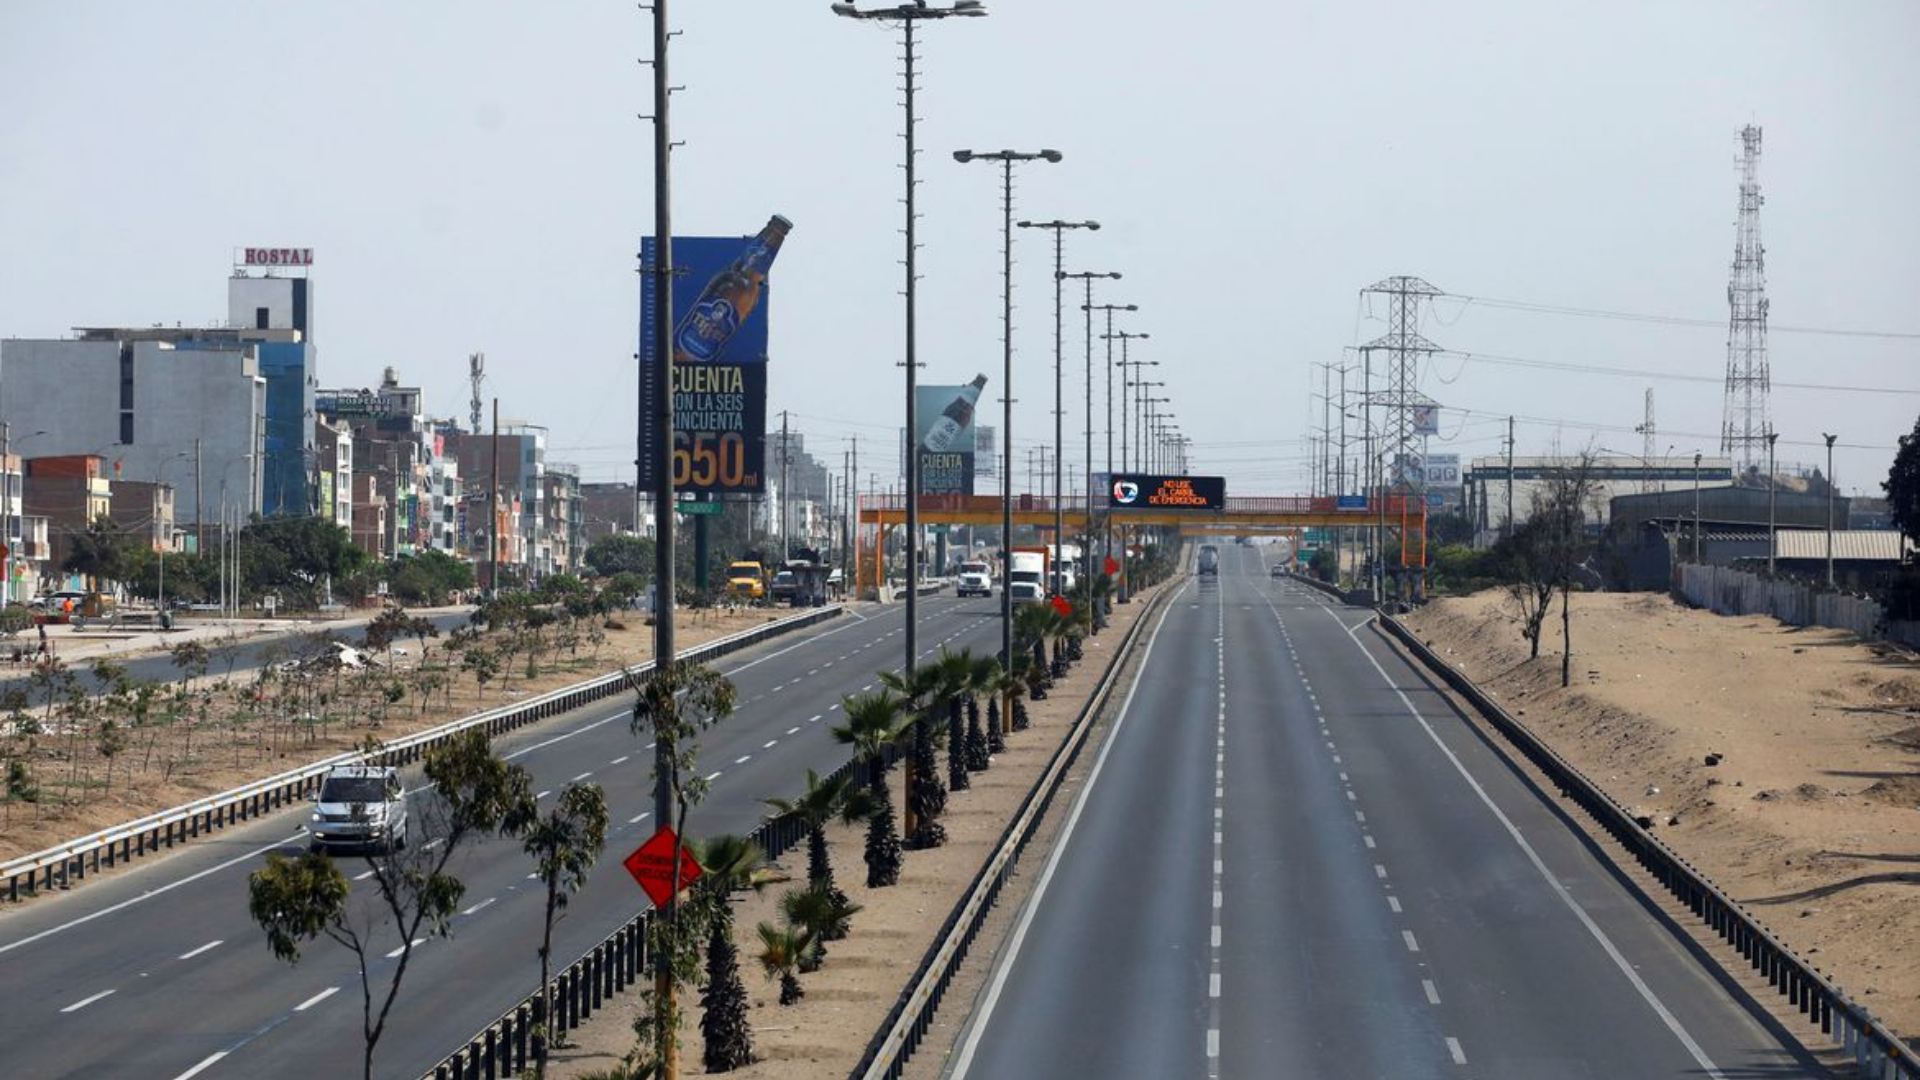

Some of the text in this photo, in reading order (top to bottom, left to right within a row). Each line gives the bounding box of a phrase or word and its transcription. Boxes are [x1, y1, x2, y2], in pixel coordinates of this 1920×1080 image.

[245, 248, 312, 264] HOSTAL
[670, 366, 744, 393] CUENTA
[697, 393, 713, 411] LA
[716, 393, 744, 411] SEIS
[672, 412, 743, 430] INCUENTA
[672, 431, 744, 486] 650
[922, 454, 963, 469] CUENTA
